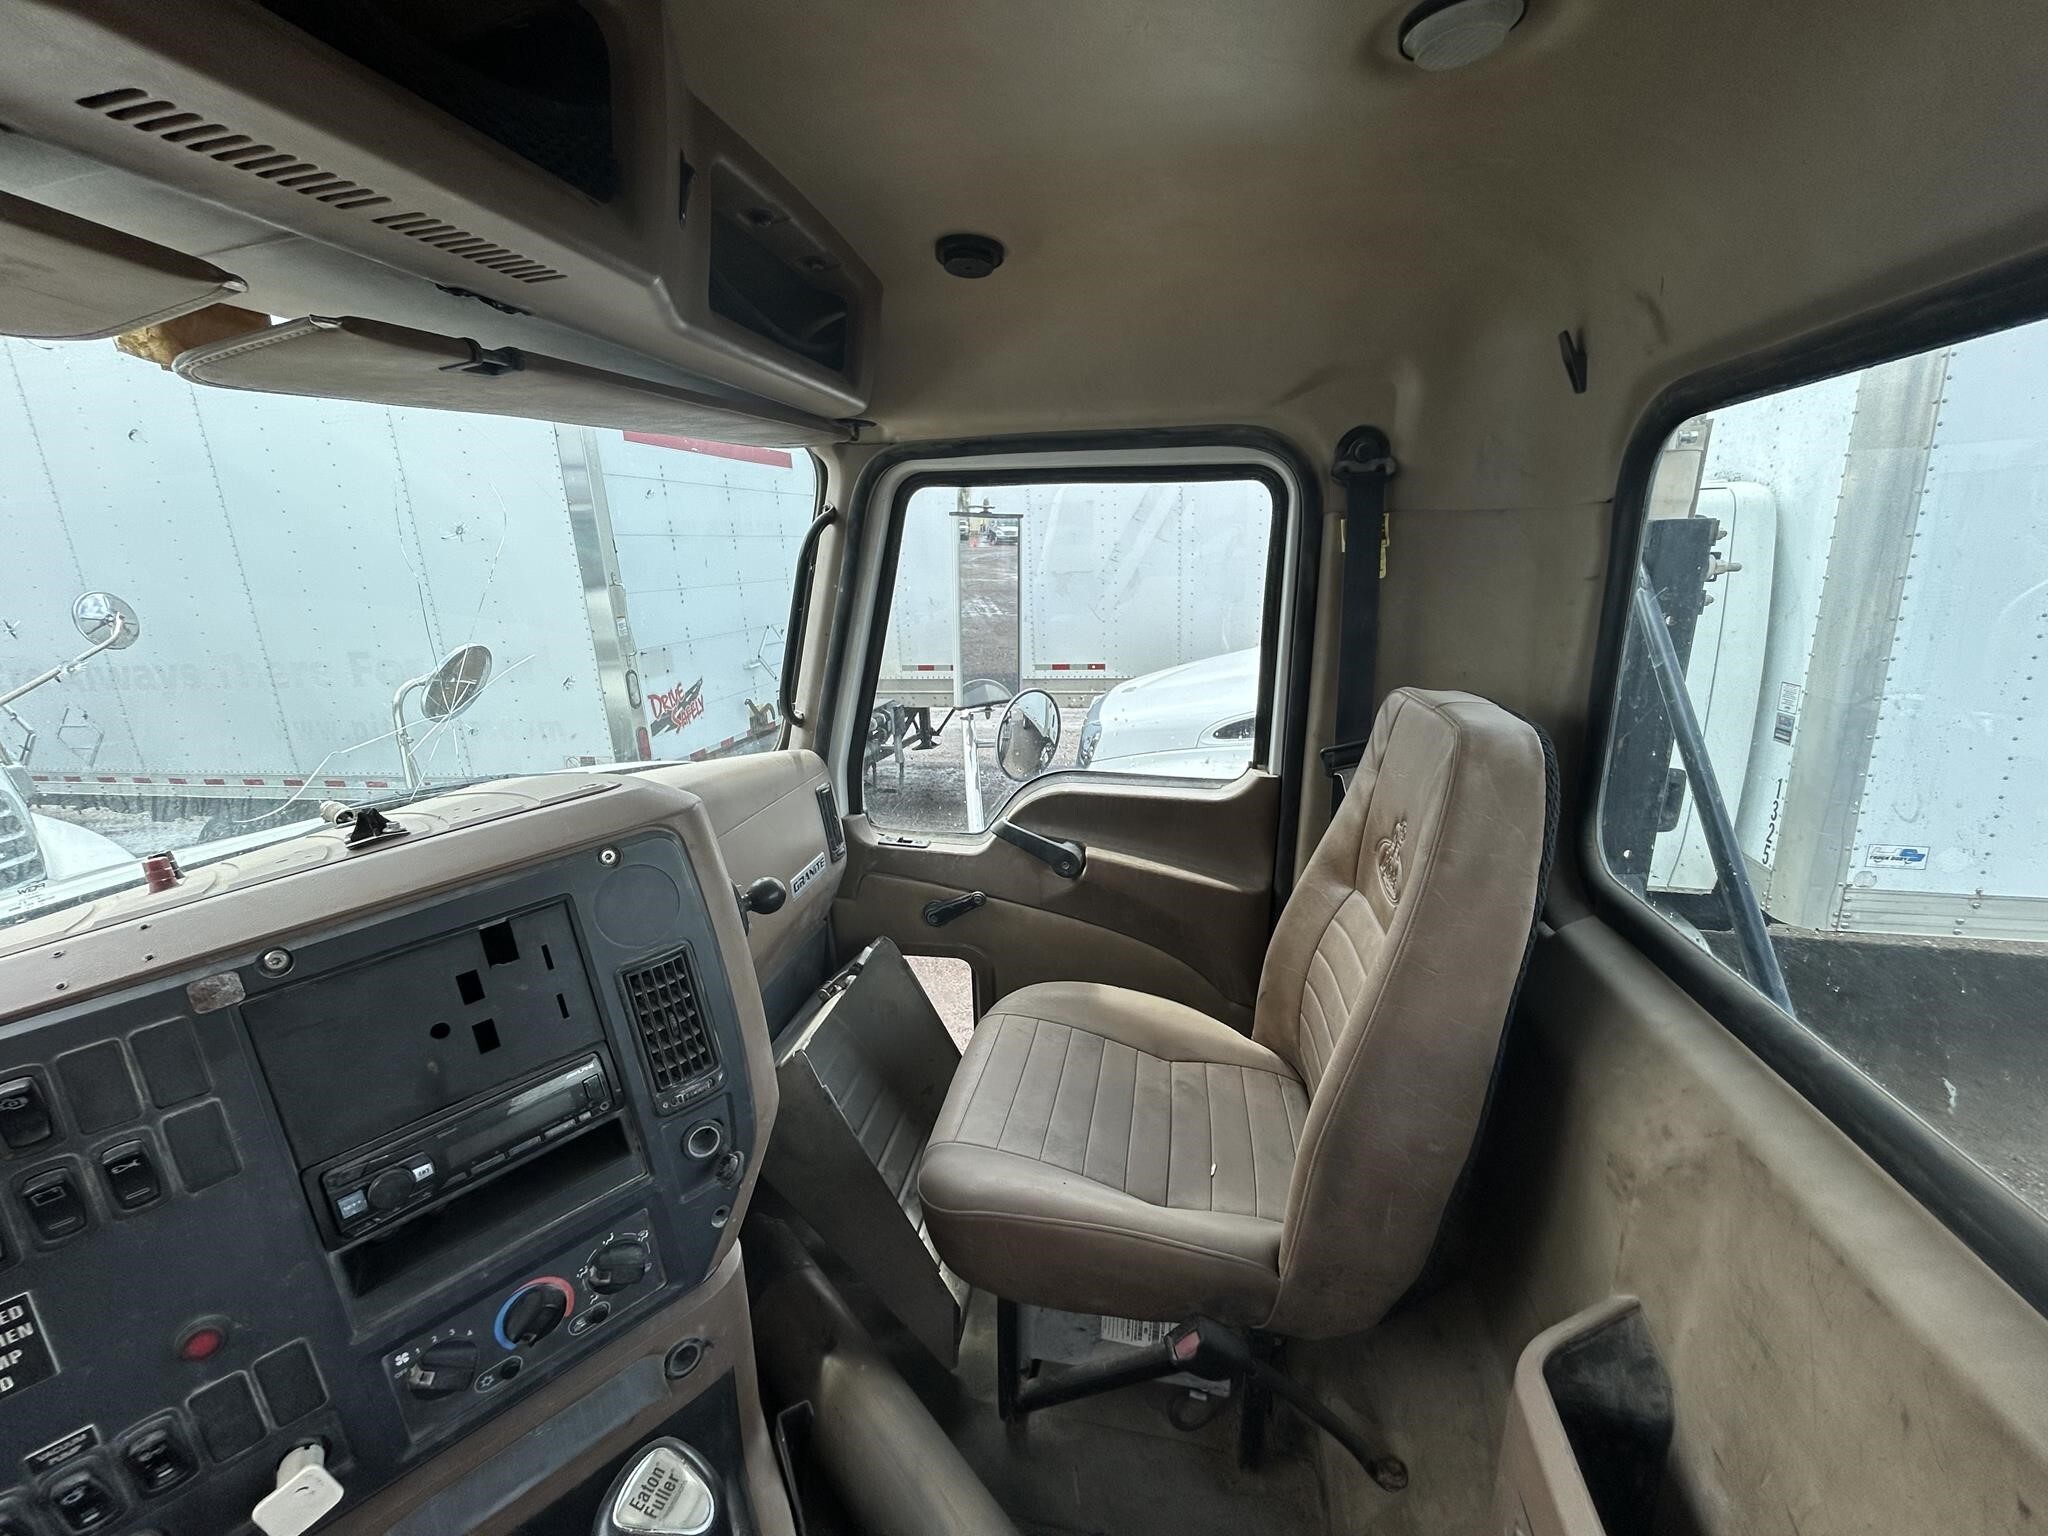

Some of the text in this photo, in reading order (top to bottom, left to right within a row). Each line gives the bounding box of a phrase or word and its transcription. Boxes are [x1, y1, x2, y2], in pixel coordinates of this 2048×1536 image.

[648, 682, 684, 720] DRIVE
[672, 694, 705, 734] SAFELY
[1762, 777, 1783, 865] 1325
[793, 857, 826, 893] GRANITE
[629, 1466, 665, 1512] Eaton
[644, 1472, 680, 1519] Fuller
